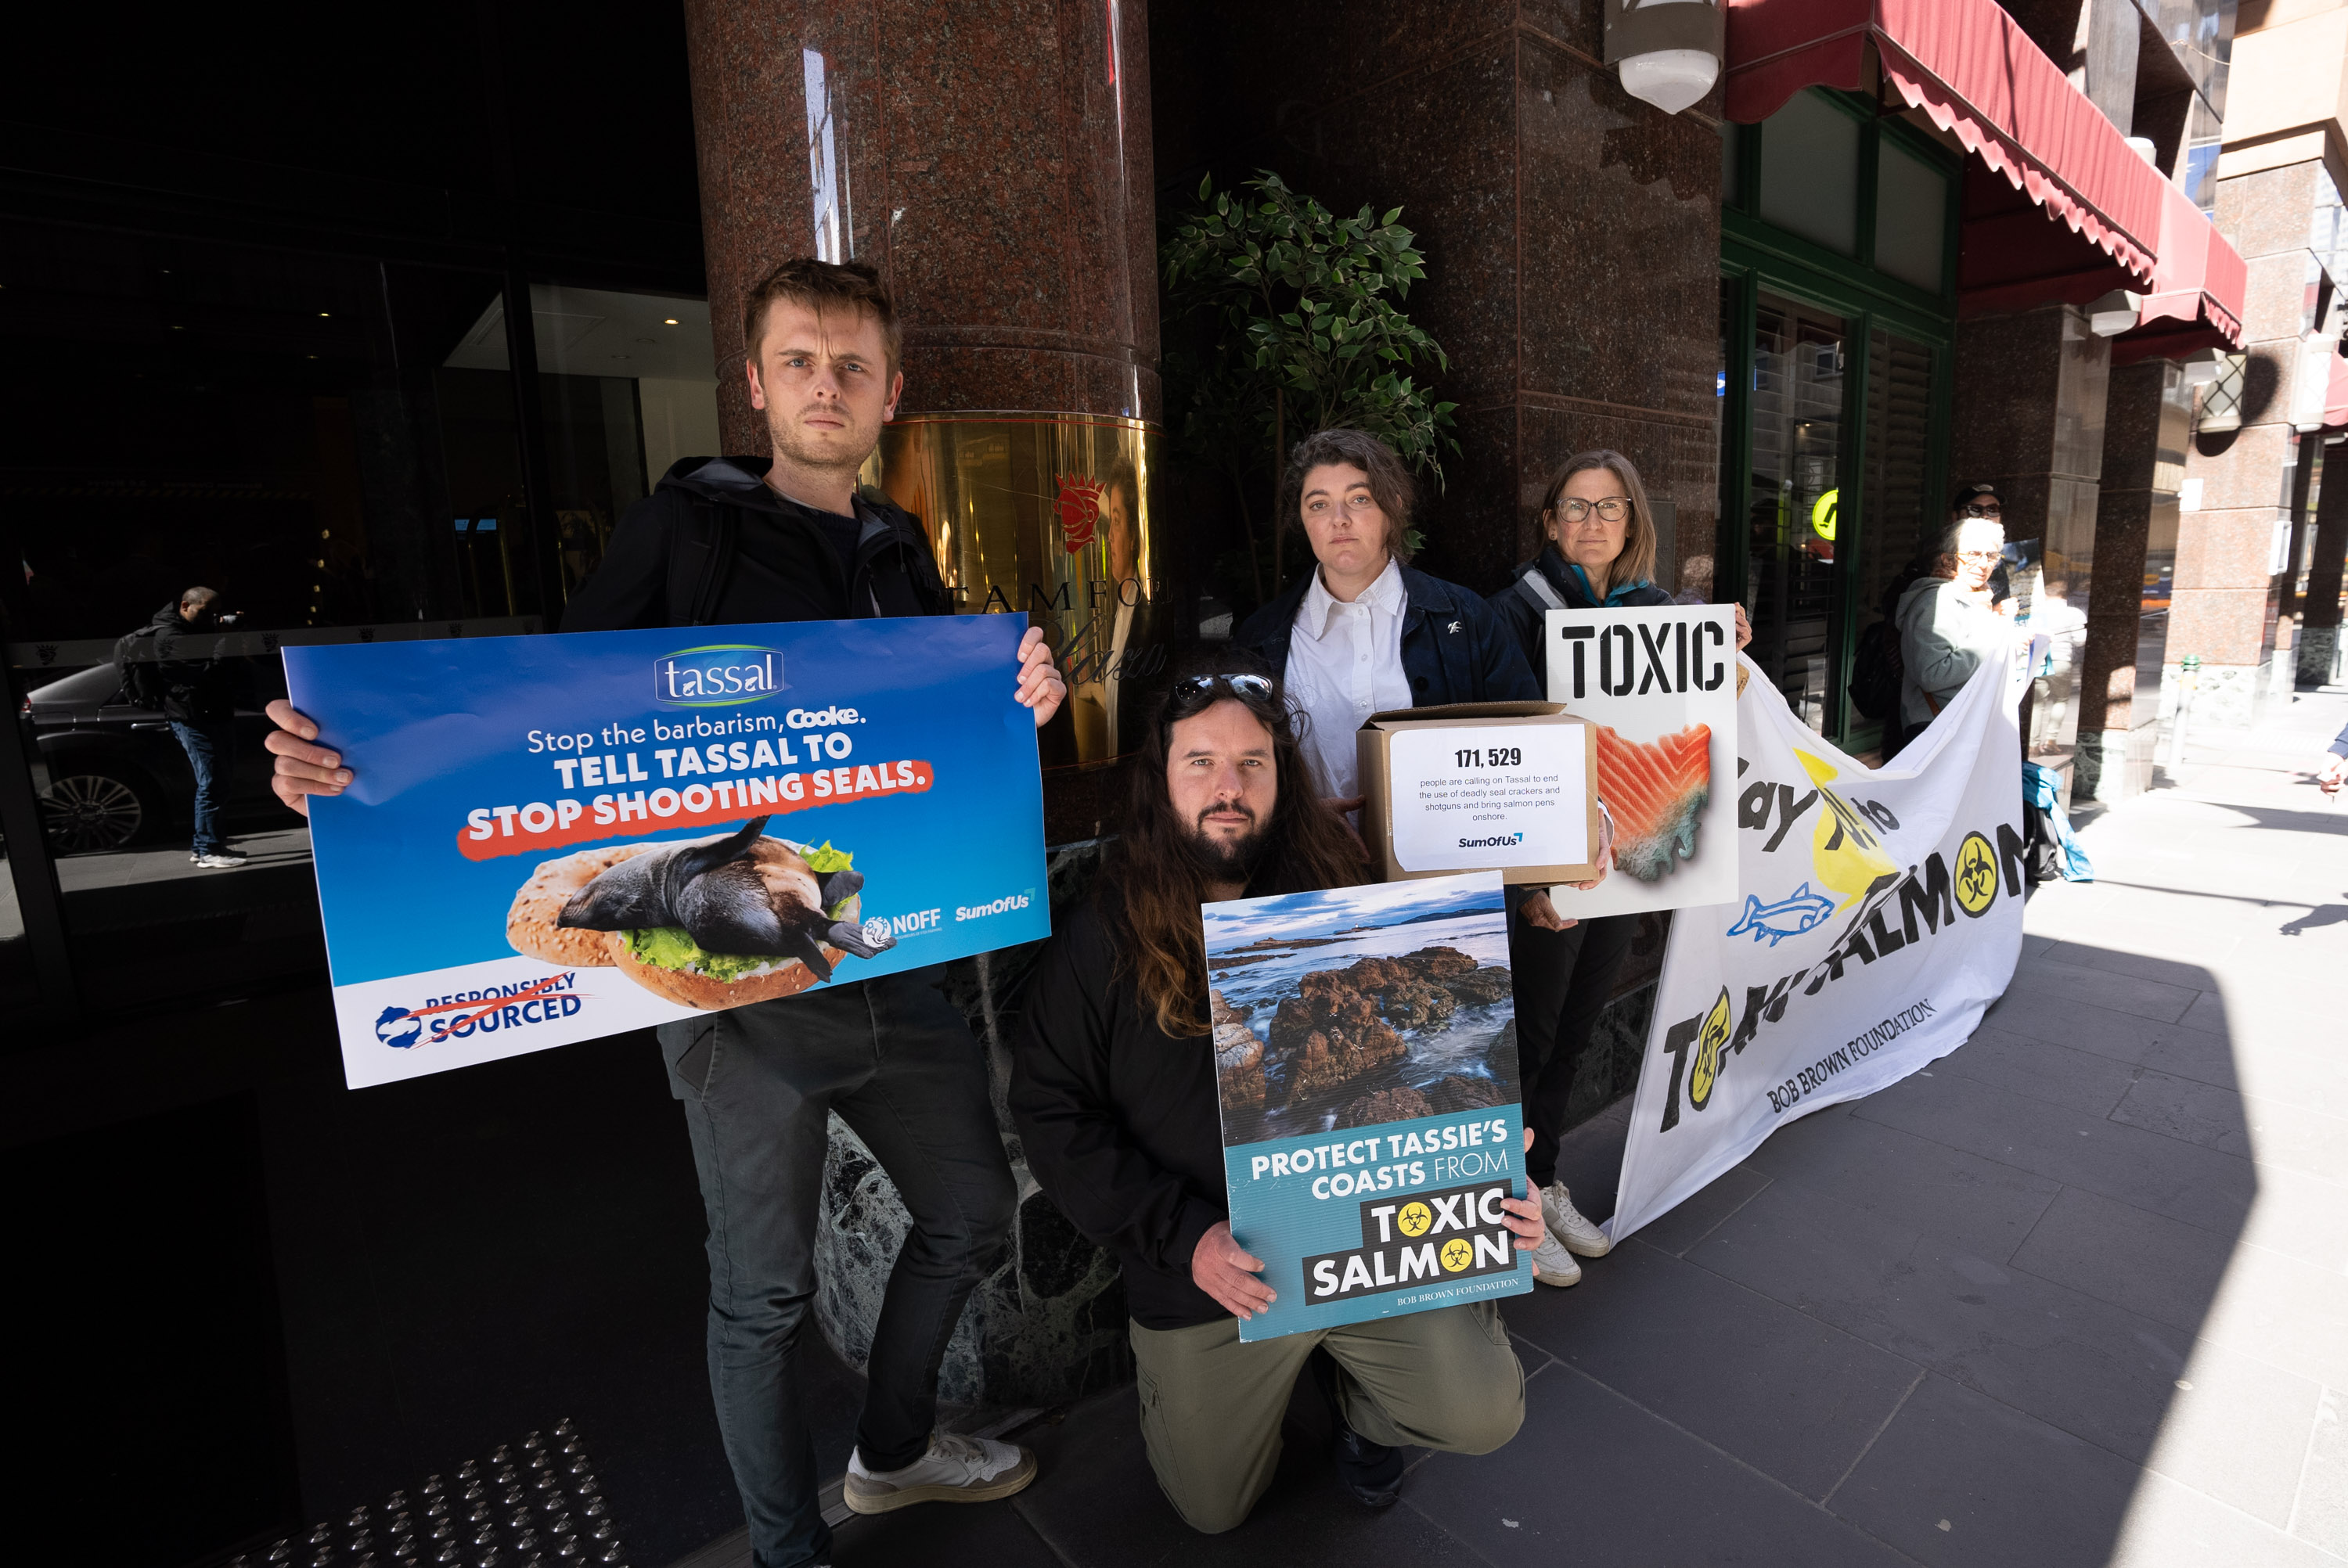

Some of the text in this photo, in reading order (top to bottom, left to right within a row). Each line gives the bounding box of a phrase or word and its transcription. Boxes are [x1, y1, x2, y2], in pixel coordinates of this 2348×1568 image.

[664, 654, 774, 697] tassal
[1562, 621, 1724, 699] TOXIC
[528, 706, 866, 755] Stop the barbarism, Cooke.
[554, 732, 852, 789] TELL TASSAL TO
[1455, 747, 1522, 768] 171, 529
[467, 761, 926, 840] STOP SHOOTING SEALS.
[1421, 779, 1446, 788] people
[1464, 777, 1490, 786] calling
[1425, 802, 1461, 811] shotguns
[1481, 800, 1501, 809] bring
[1535, 799, 1555, 808] pens
[1460, 789, 1487, 798] deadly
[1508, 787, 1543, 796] crackers
[1738, 757, 1819, 852] ay
[1850, 797, 1900, 835] to
[1459, 836, 1517, 847] SumOfUs
[892, 908, 941, 934] NOFF
[956, 894, 1029, 922] SumOfUs
[430, 994, 582, 1043] SOURCED
[1766, 998, 1937, 1113] BOB BROWN FOUNDATION
[1251, 1119, 1507, 1180] PROTECT TASSIE'S
[1312, 1149, 1508, 1199] COASTS FROM
[1397, 1278, 1518, 1306] BOB BROWN FOUNDATION
